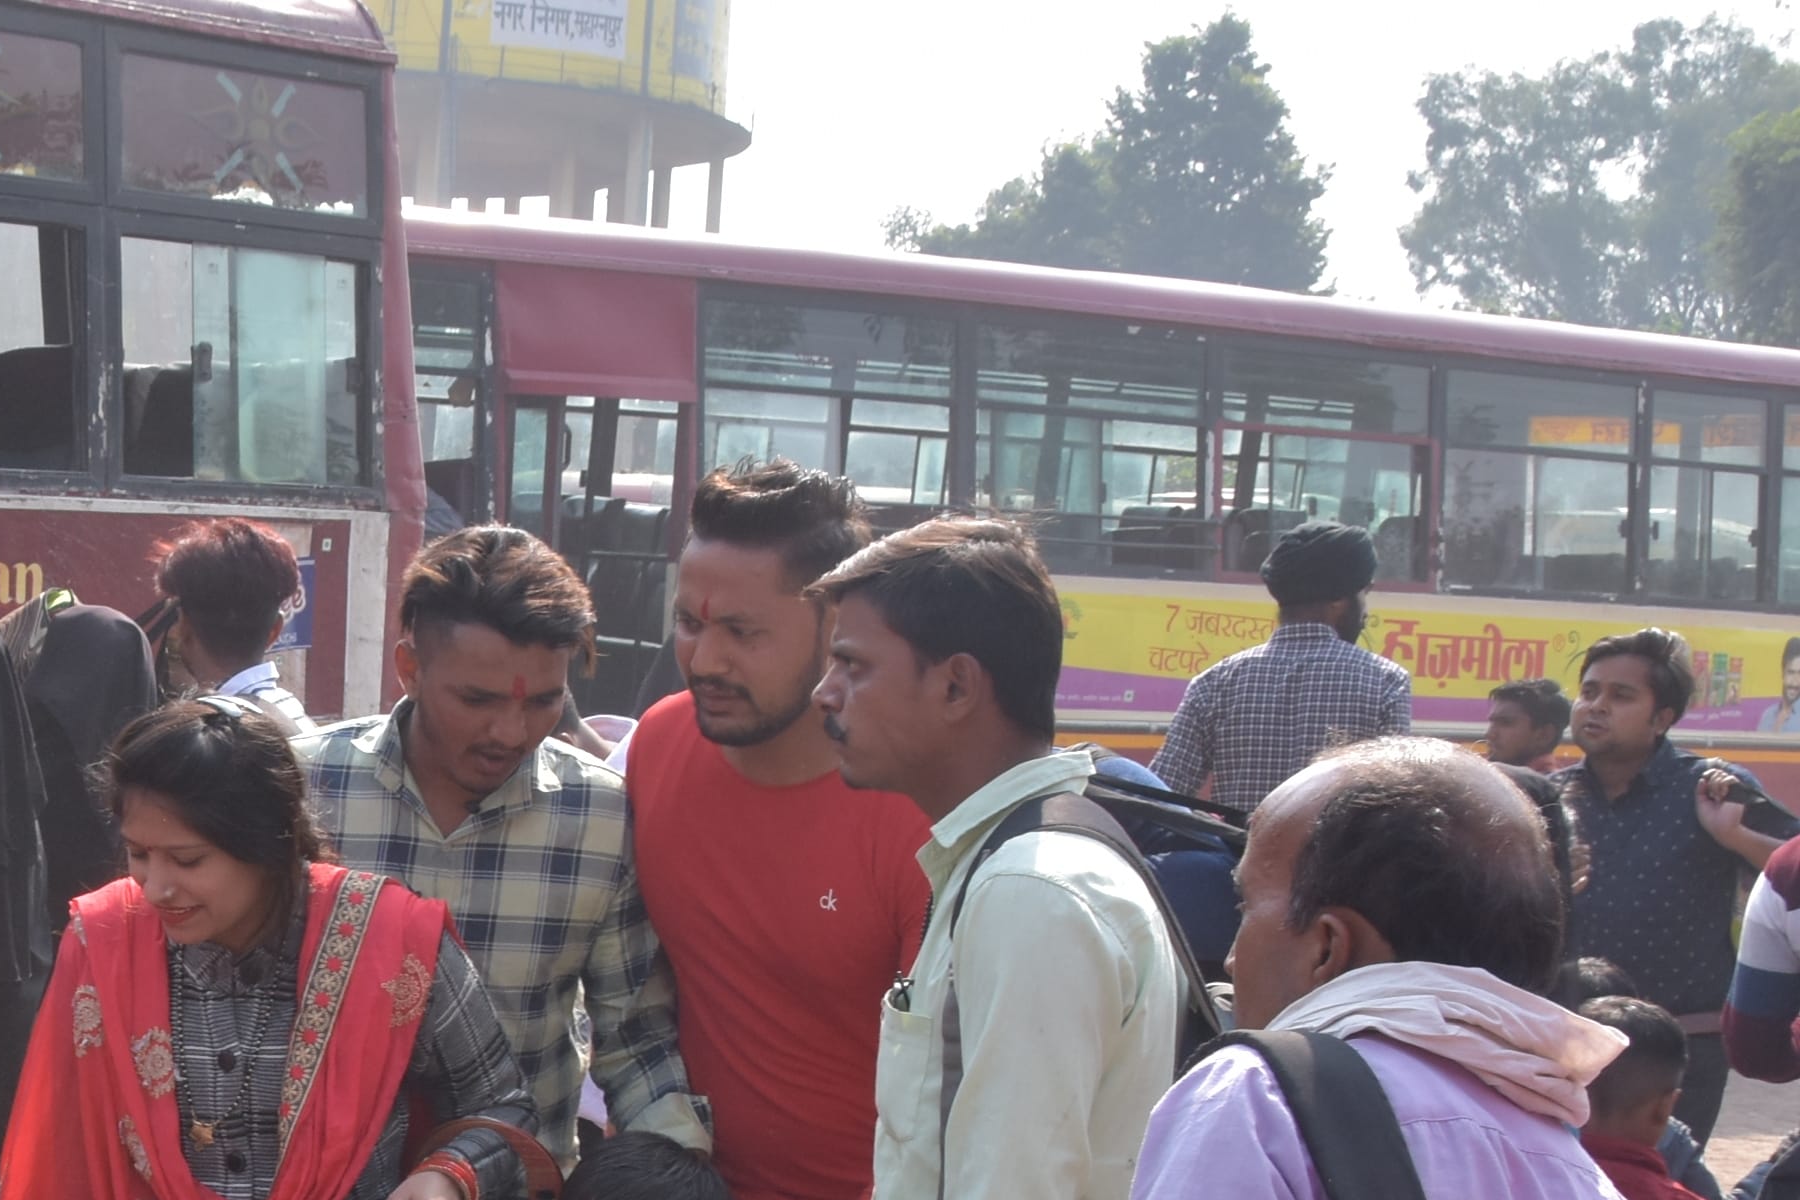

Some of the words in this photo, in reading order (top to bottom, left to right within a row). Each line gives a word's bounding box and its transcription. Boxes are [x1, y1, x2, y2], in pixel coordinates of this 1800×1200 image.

[493, 1, 526, 32] नगर
[1166, 604, 1181, 633] 7
[1149, 642, 1210, 674] चटपटे
